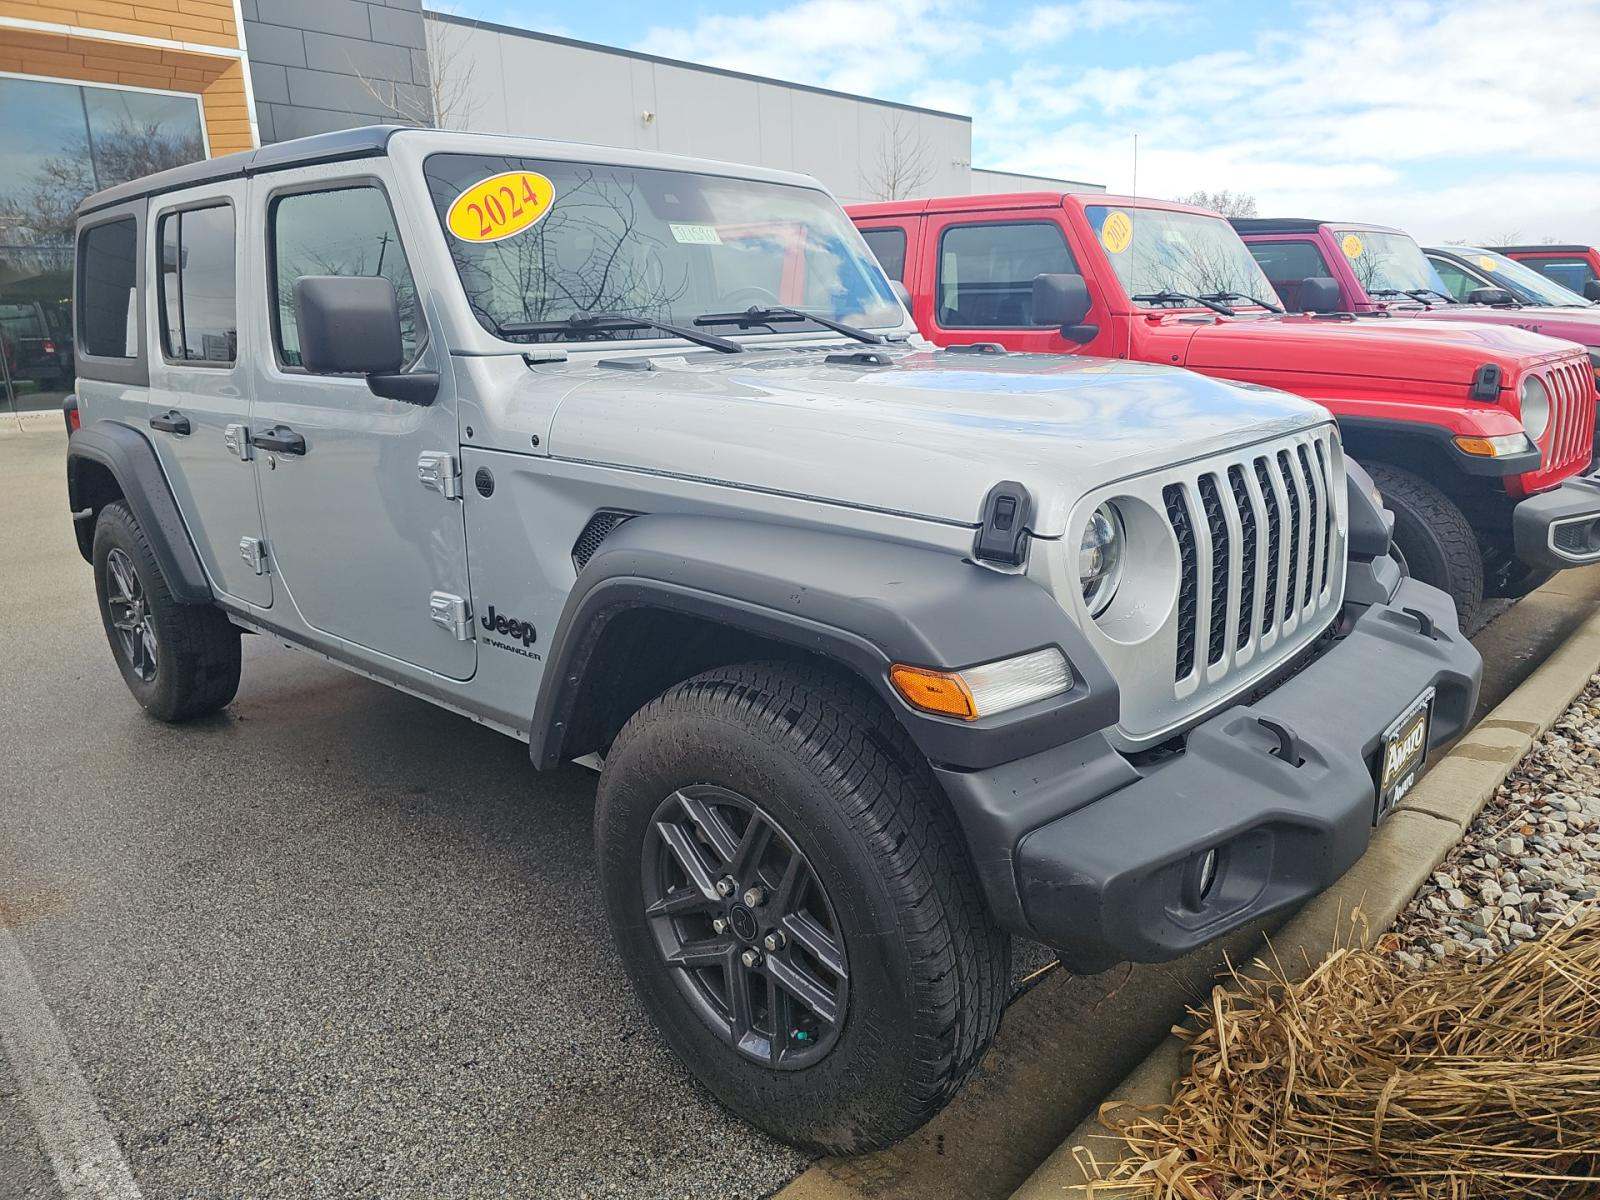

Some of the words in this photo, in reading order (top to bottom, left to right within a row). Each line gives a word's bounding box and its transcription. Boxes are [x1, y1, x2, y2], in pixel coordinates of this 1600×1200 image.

[467, 175, 538, 236] 2024
[481, 605, 537, 647] Jeep
[491, 640, 542, 661] WRANGLER
